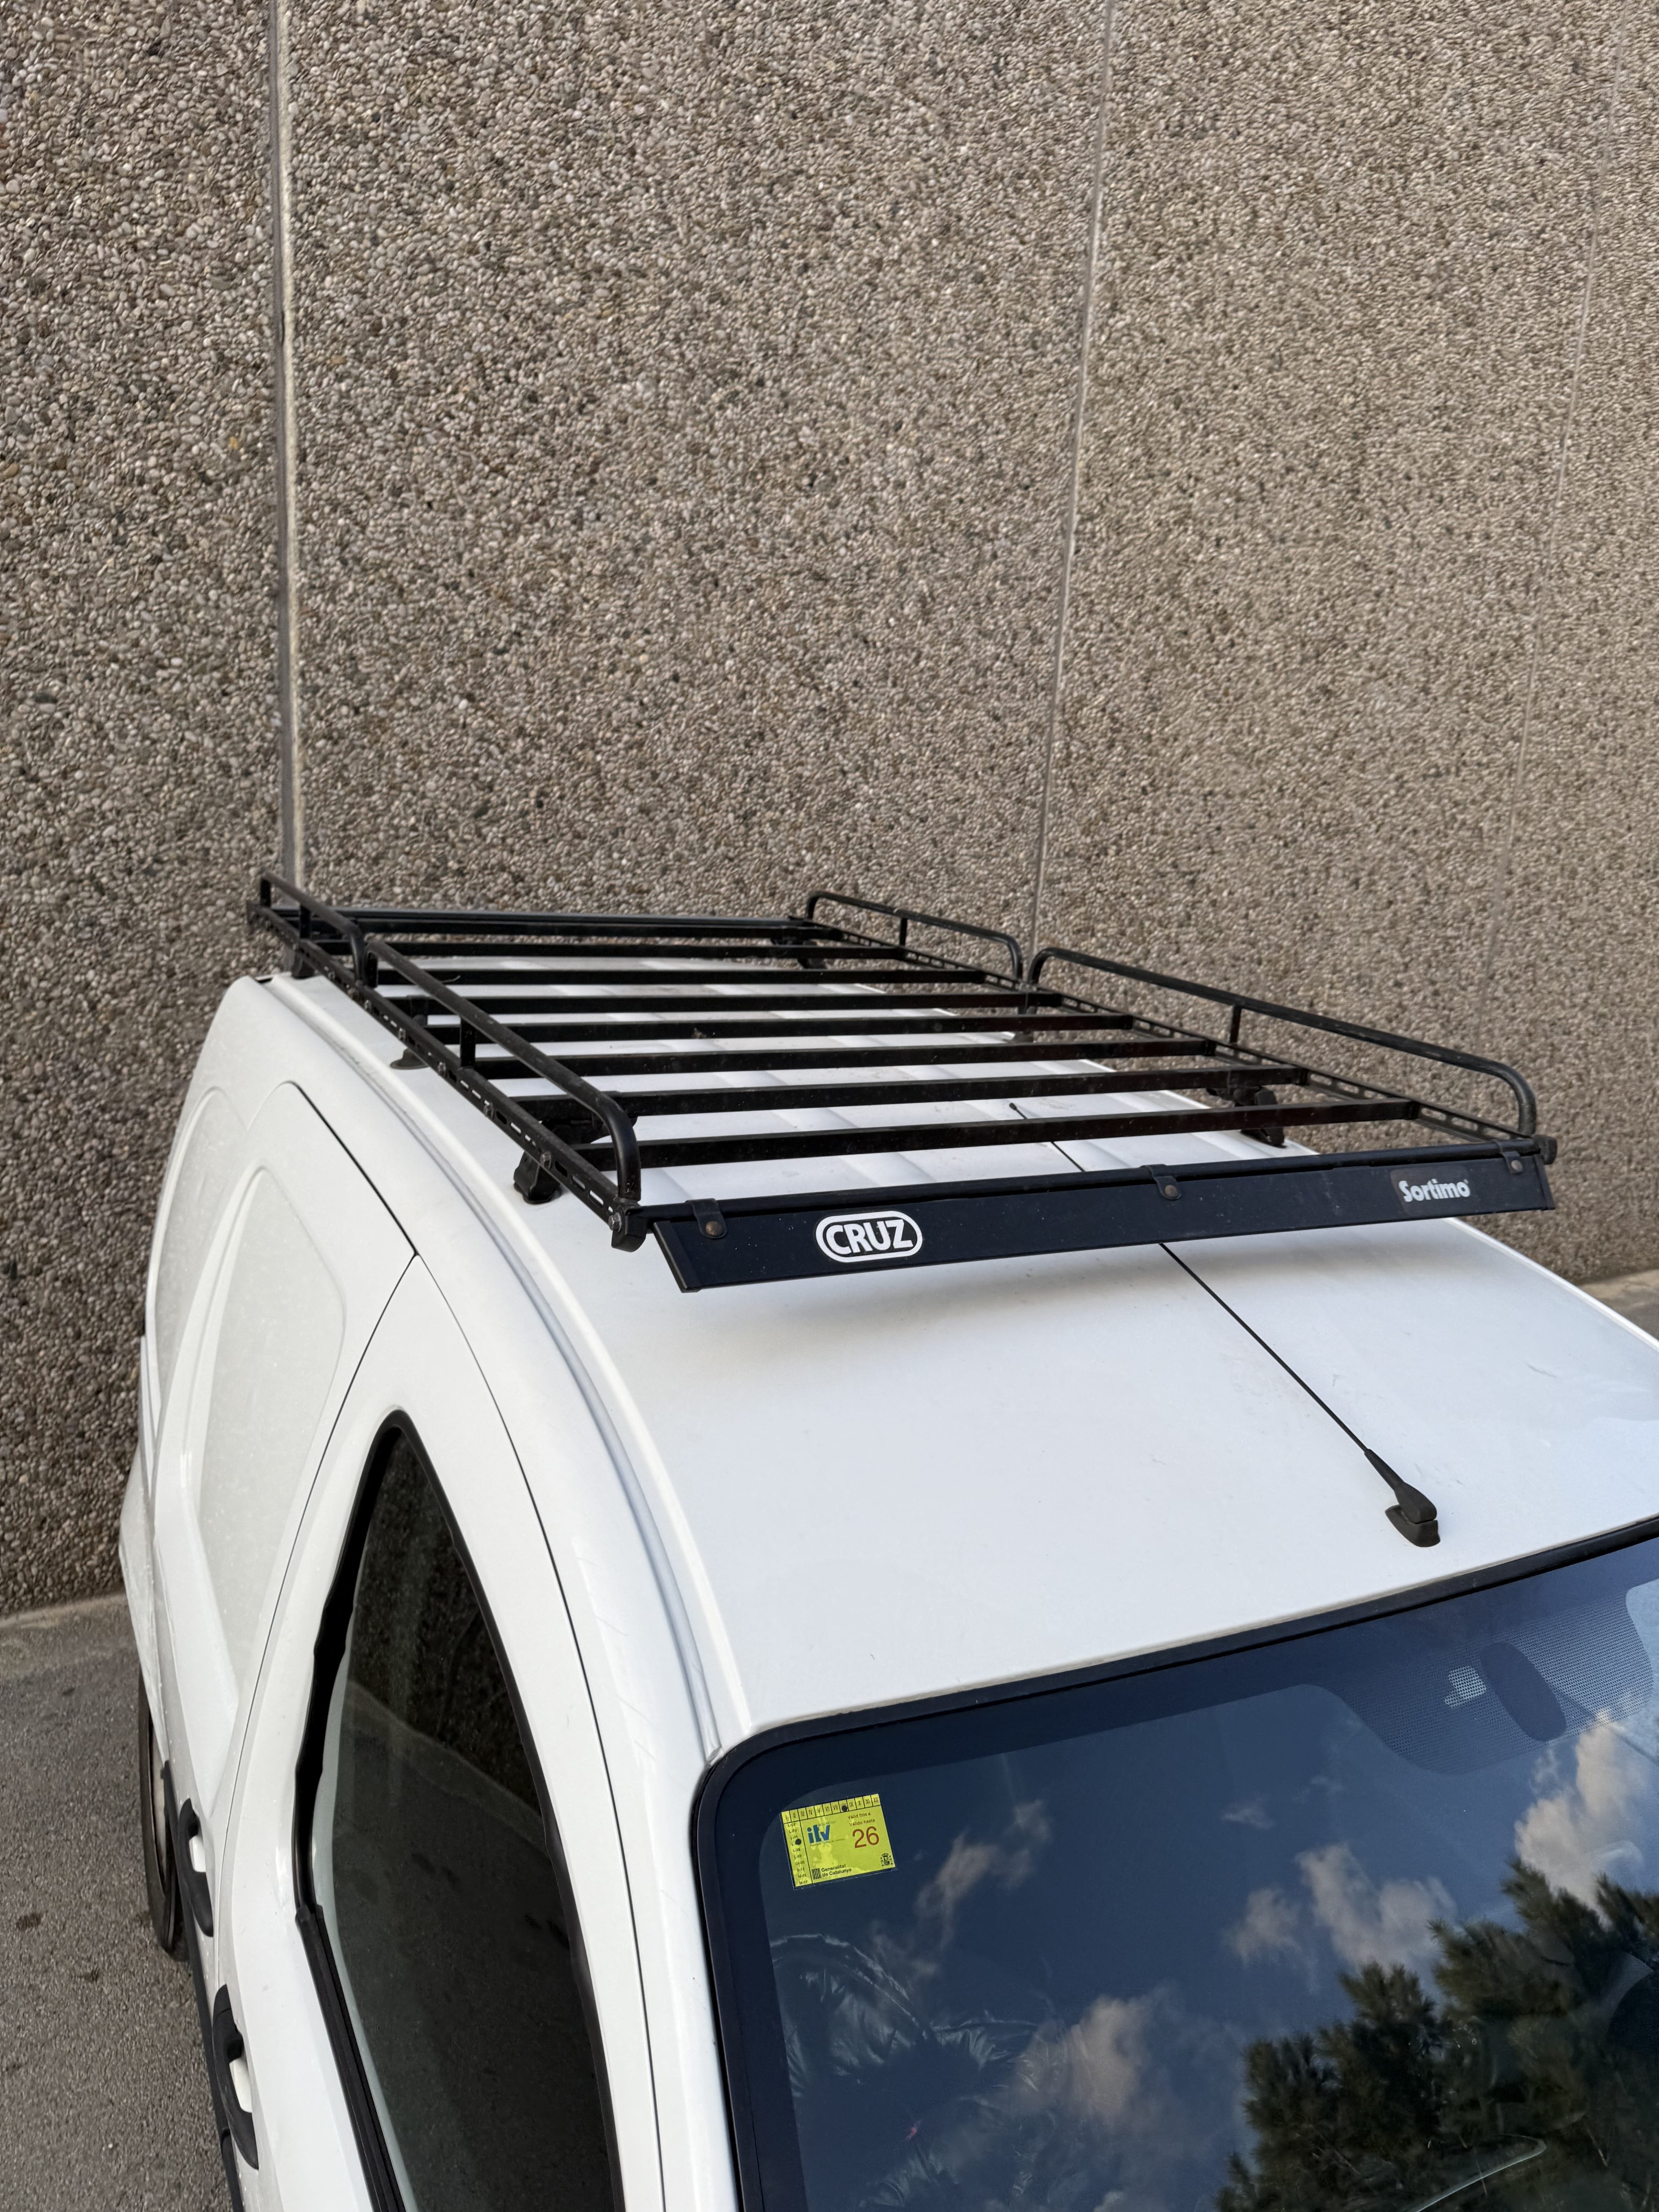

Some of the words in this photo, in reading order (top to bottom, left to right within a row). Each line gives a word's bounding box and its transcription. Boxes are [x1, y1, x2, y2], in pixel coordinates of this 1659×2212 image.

[1398, 1178, 1470, 1202] Sortimo
[826, 1219, 914, 1255] CRUZ
[807, 1824, 830, 1844] itv
[852, 1826, 879, 1848] 26
